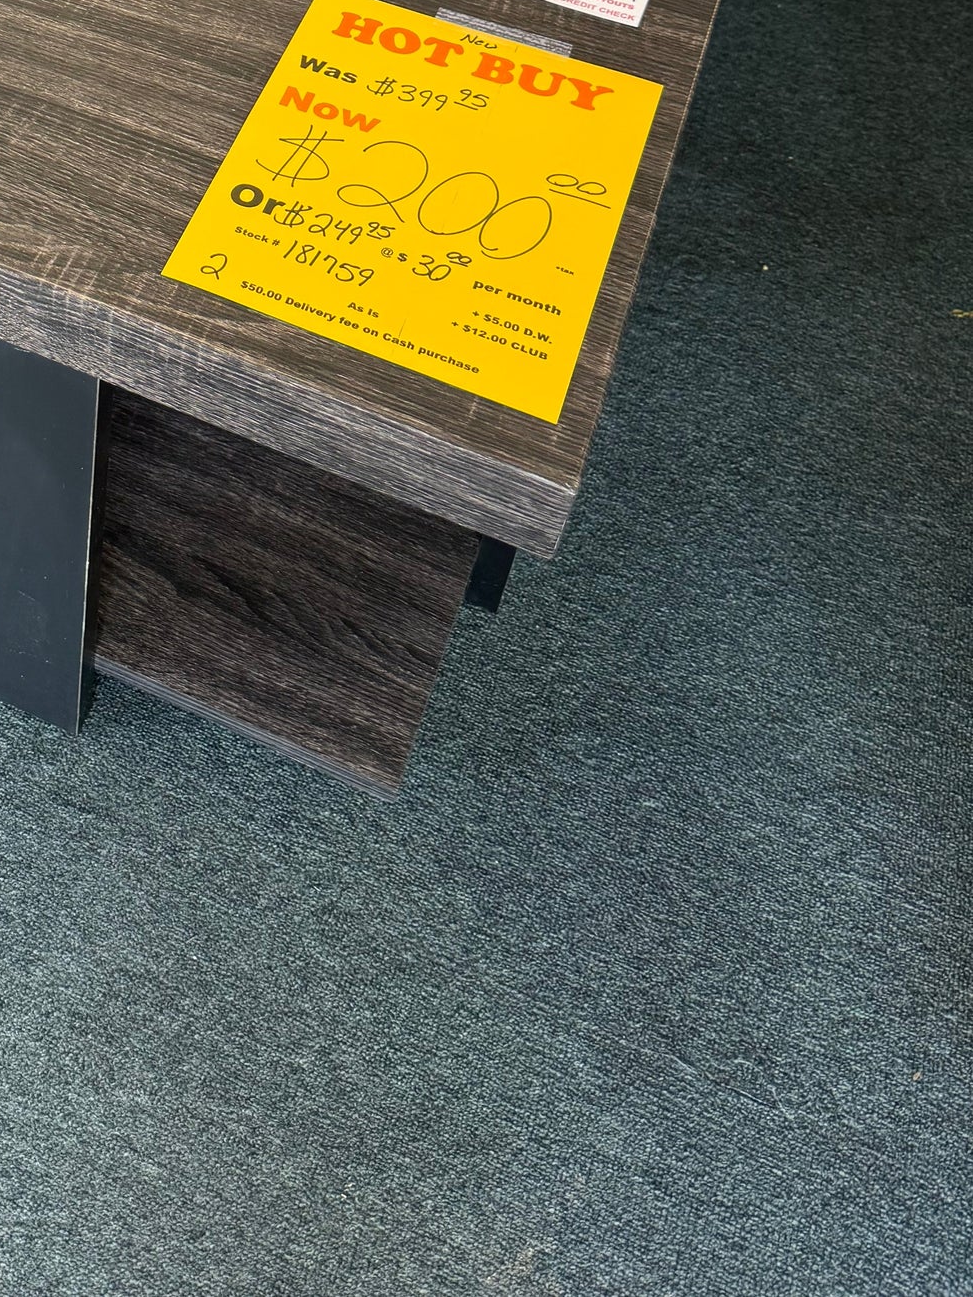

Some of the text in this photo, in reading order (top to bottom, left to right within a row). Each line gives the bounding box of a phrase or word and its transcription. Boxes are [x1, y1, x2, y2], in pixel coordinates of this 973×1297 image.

[599, 7, 635, 21] CHECK
[300, 55, 357, 83] Was
[331, 11, 614, 110] HOT BUY
[279, 86, 381, 133] Now
[200, 253, 228, 280] 2
[231, 184, 282, 219] Or
[379, 247, 396, 259] @
[397, 253, 408, 262] $
[473, 281, 503, 294] per
[507, 292, 561, 316] month
[235, 226, 268, 243] Stock
[283, 240, 374, 287] 181759
[240, 281, 479, 373] $50.00 Delivery fee on Cash purchase
[347, 302, 379, 318] As Is
[463, 325, 507, 345] $12.00
[511, 342, 547, 360] CLUB
[483, 314, 520, 332] $5.00
[524, 328, 552, 344] D.W.
